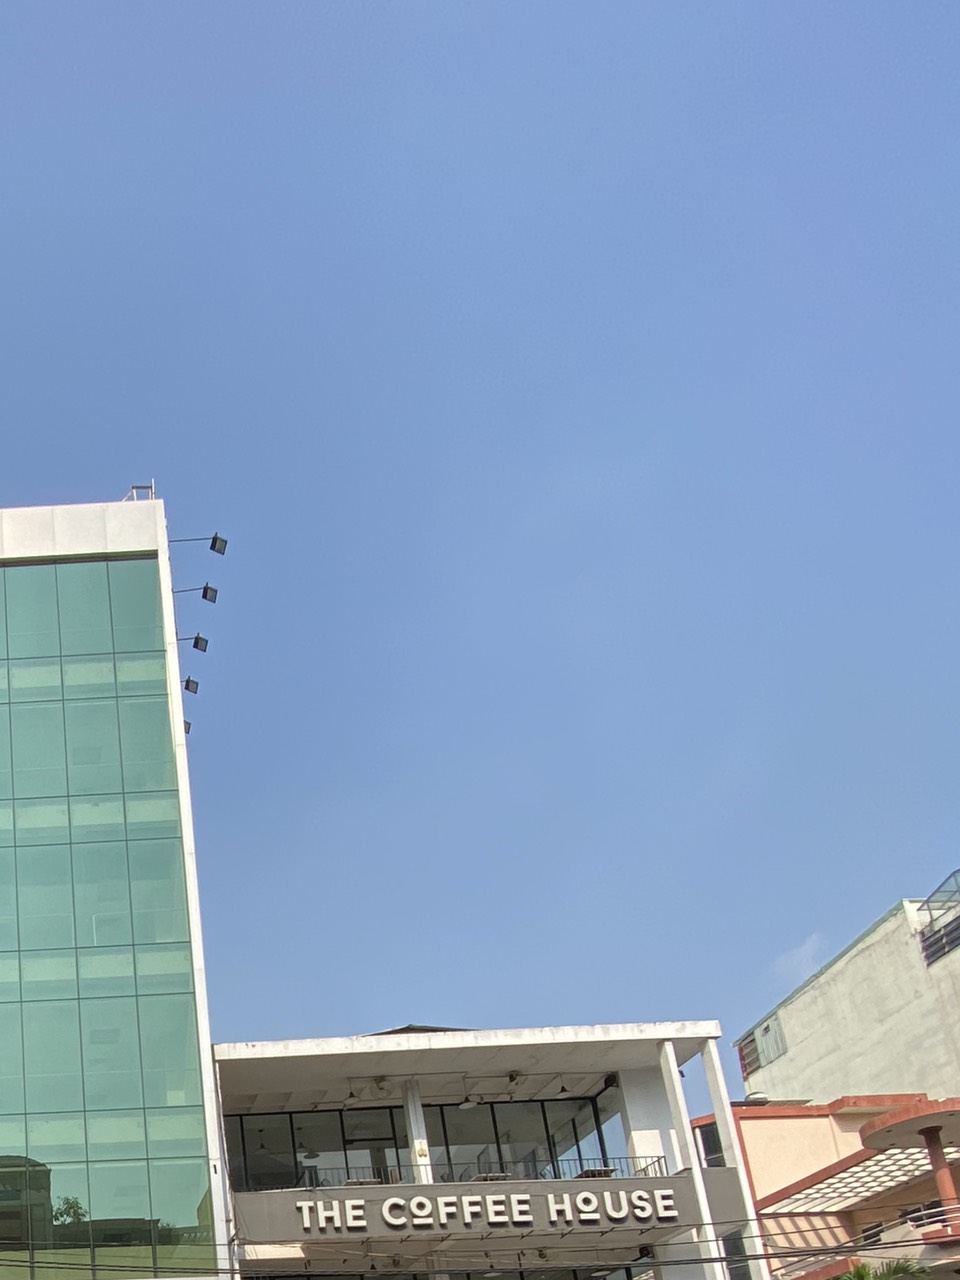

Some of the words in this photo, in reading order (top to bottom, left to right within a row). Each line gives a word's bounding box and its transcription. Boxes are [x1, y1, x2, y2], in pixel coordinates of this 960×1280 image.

[296, 1199, 368, 1230] THE
[380, 1194, 534, 1227] COFFEE
[547, 1188, 679, 1223] HOUSE
